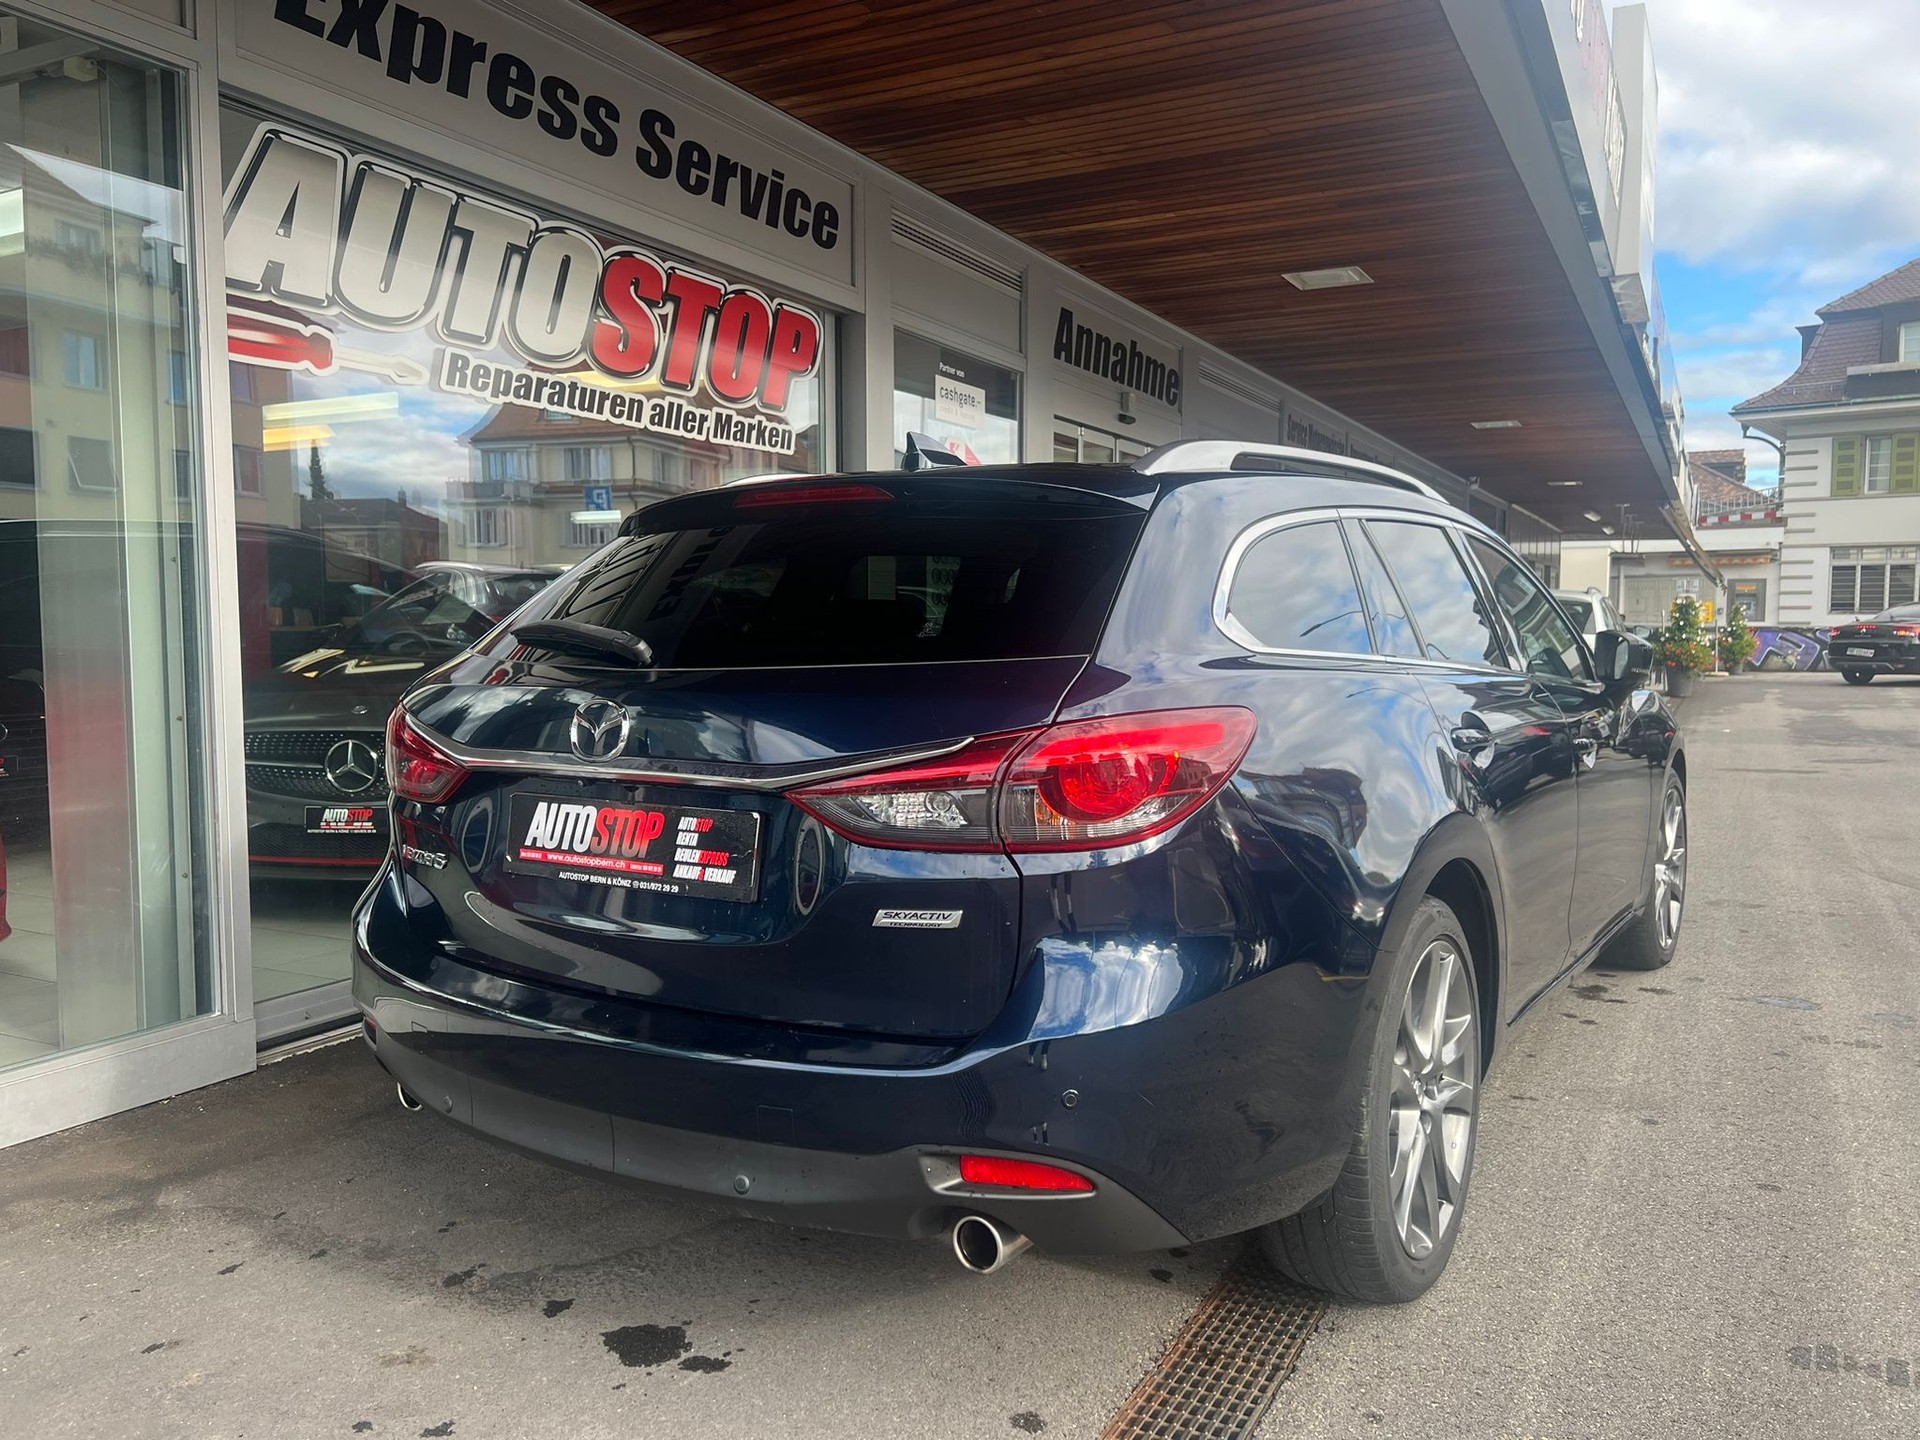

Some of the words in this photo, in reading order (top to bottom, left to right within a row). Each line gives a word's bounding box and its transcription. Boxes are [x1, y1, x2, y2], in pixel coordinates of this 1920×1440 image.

[636, 108, 840, 250] Service
[224, 127, 820, 410] AUTOSTOP
[1054, 306, 1180, 407] Annahme
[446, 352, 644, 423] Reparaturen
[650, 401, 709, 436] aller
[712, 411, 793, 451] Marken
[321, 808, 374, 822] AUTOSTOP
[523, 801, 666, 859] AUTOSTOP
[677, 816, 714, 833] AUTOSTOP
[558, 871, 590, 882] AUTOSTOP
[882, 911, 952, 920] SKYACTIV
